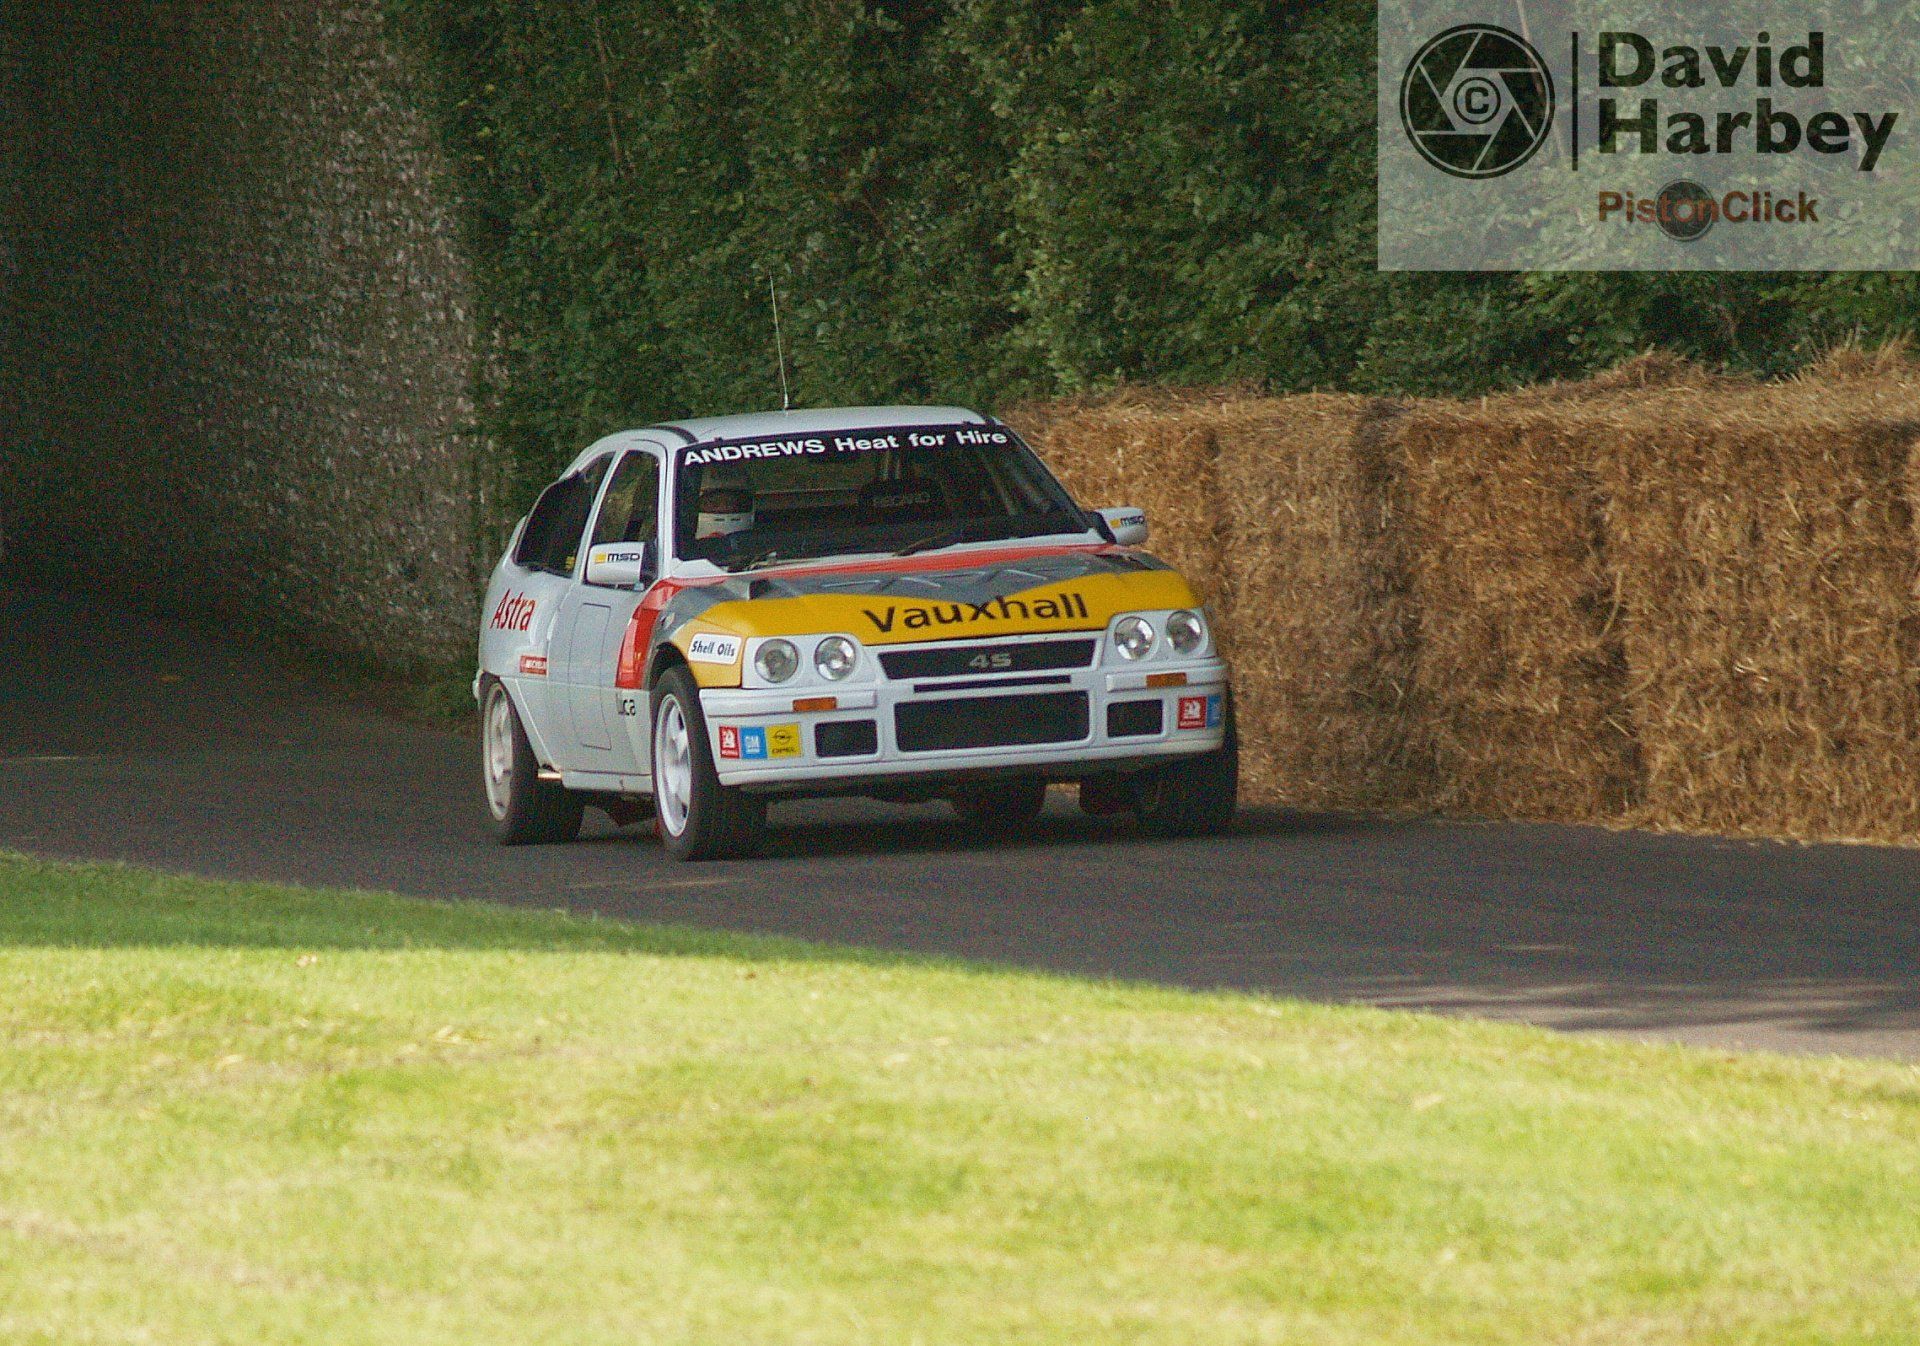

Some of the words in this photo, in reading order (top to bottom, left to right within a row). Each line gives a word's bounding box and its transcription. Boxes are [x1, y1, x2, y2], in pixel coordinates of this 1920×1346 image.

[684, 439, 826, 466] ANDREWS
[834, 434, 900, 452] Heat
[908, 432, 946, 447] for
[956, 430, 1008, 445] Hire
[490, 587, 537, 632] Astra
[863, 592, 1089, 633] Vauxhall
[692, 639, 714, 654] Shell
[717, 643, 736, 657] Oils
